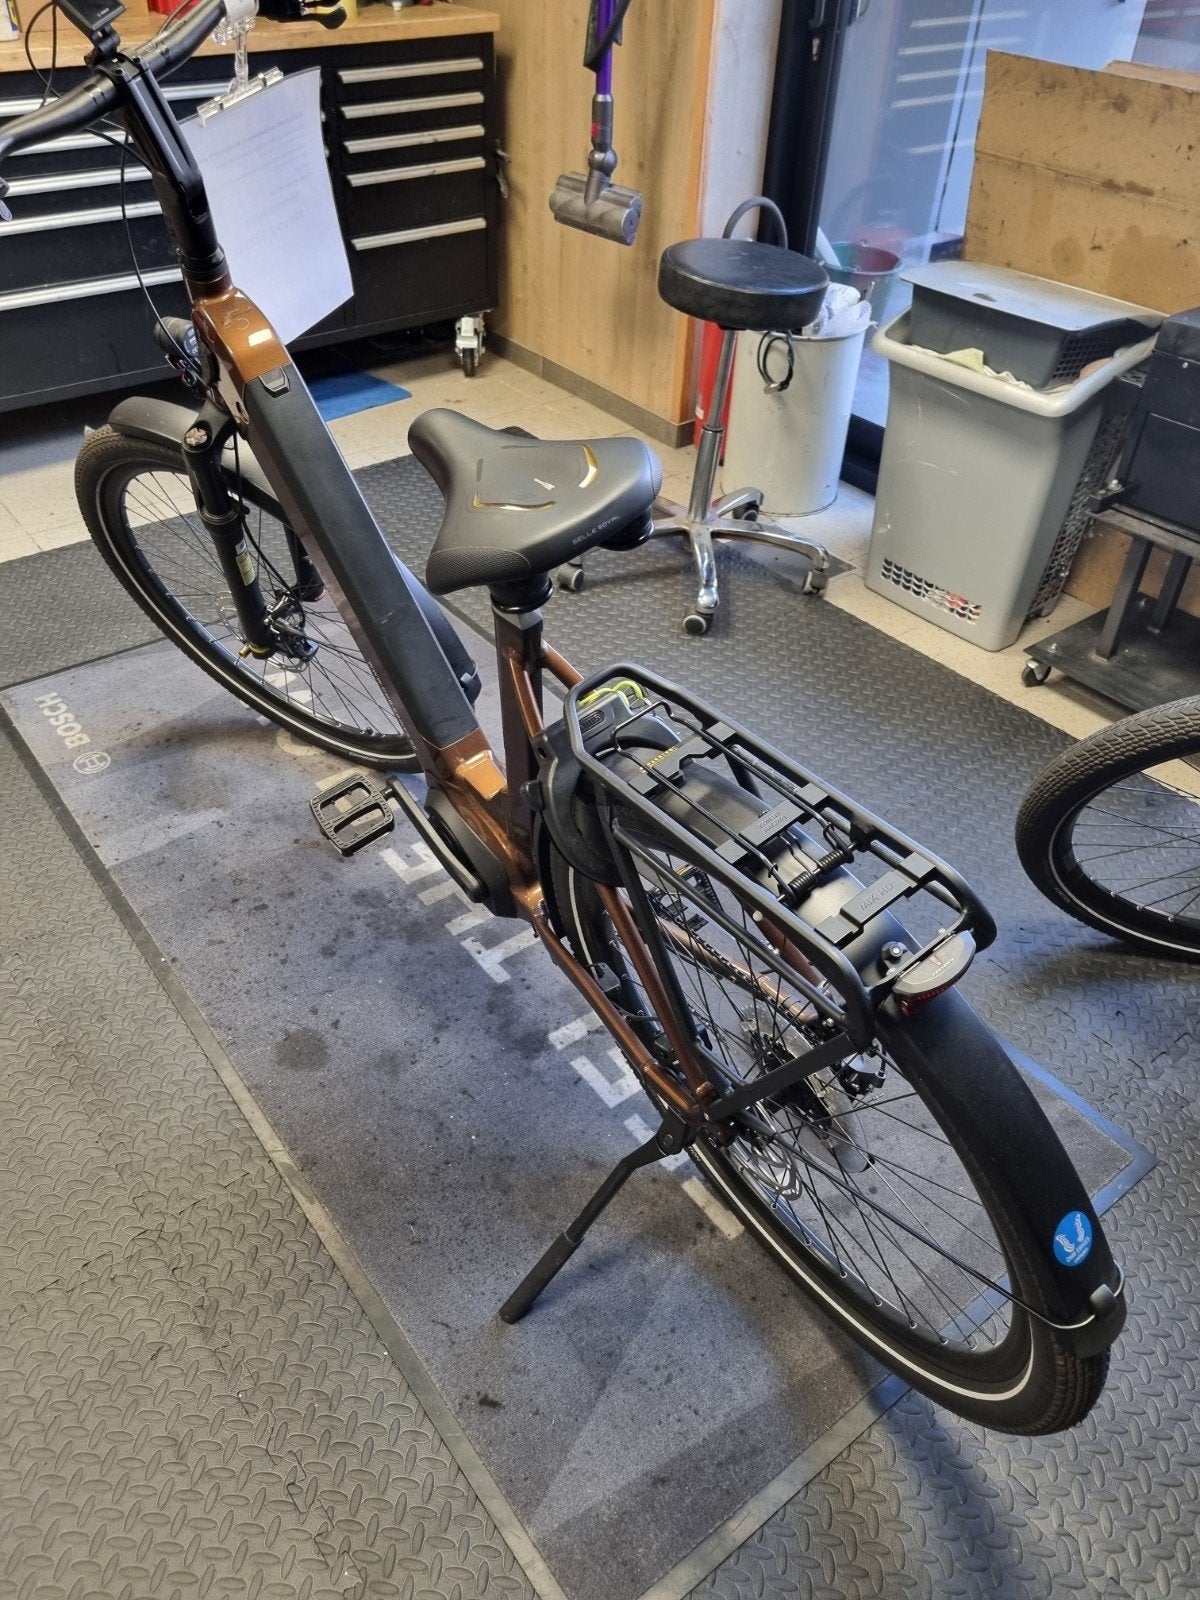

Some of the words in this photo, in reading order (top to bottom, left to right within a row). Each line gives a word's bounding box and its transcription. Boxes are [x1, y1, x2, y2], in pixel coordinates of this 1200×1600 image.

[572, 528, 597, 545] SELLE
[597, 515, 621, 530] ROYAL
[34, 692, 92, 749] BOSCH
[857, 892, 877, 911] MIK
[879, 882, 894, 897] HD
